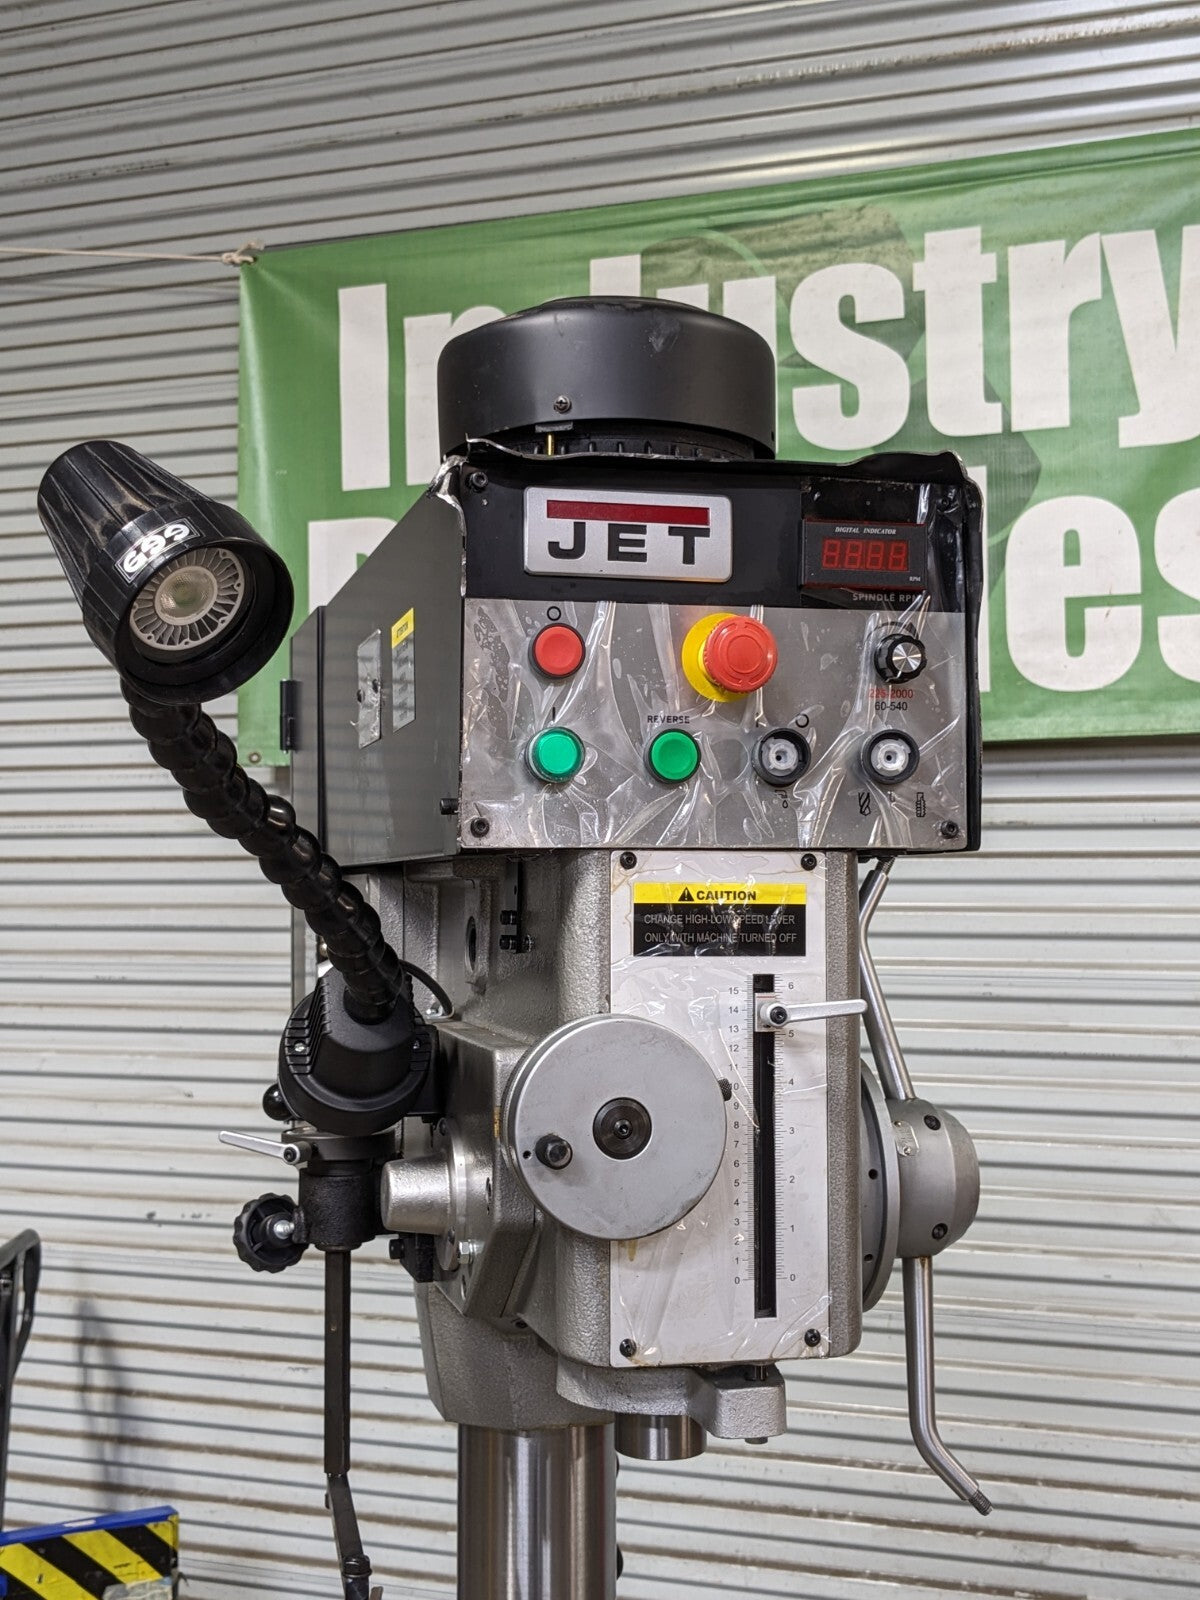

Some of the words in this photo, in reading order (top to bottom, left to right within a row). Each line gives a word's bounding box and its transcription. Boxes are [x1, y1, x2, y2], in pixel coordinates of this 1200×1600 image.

[337, 224, 1200, 491] Istry
[834, 526, 860, 534] DIGITAL
[863, 527, 897, 535] INDICATOR
[547, 521, 711, 566] JET
[852, 593, 895, 602] SPINDLE
[874, 701, 908, 711] 60-540
[647, 714, 690, 724] REVERSE
[696, 890, 757, 901] CAUTION
[643, 913, 683, 925] CHANGE
[685, 914, 732, 925] HIGH-LOW
[733, 914, 764, 925] PEED
[644, 932, 670, 943] ONLY
[696, 933, 738, 943] MACHINE
[740, 933, 777, 943] TURNED
[779, 933, 797, 943] OFF
[788, 982, 794, 990] 6
[728, 987, 740, 995] 15
[728, 1006, 740, 1014] 14
[788, 1030, 795, 1038] 5
[788, 1078, 794, 1086] 4
[733, 1102, 740, 1110] 9
[733, 1121, 740, 1129] 8
[789, 1126, 795, 1135] 3
[733, 1160, 740, 1168] 6
[733, 1179, 740, 1187] 5
[789, 1175, 795, 1184] 2
[733, 1198, 740, 1206] 4
[734, 1218, 740, 1226] 3
[790, 1224, 795, 1233] 1
[735, 1257, 740, 1265] 1
[734, 1276, 741, 1285] 0
[789, 1273, 796, 1282] 0
